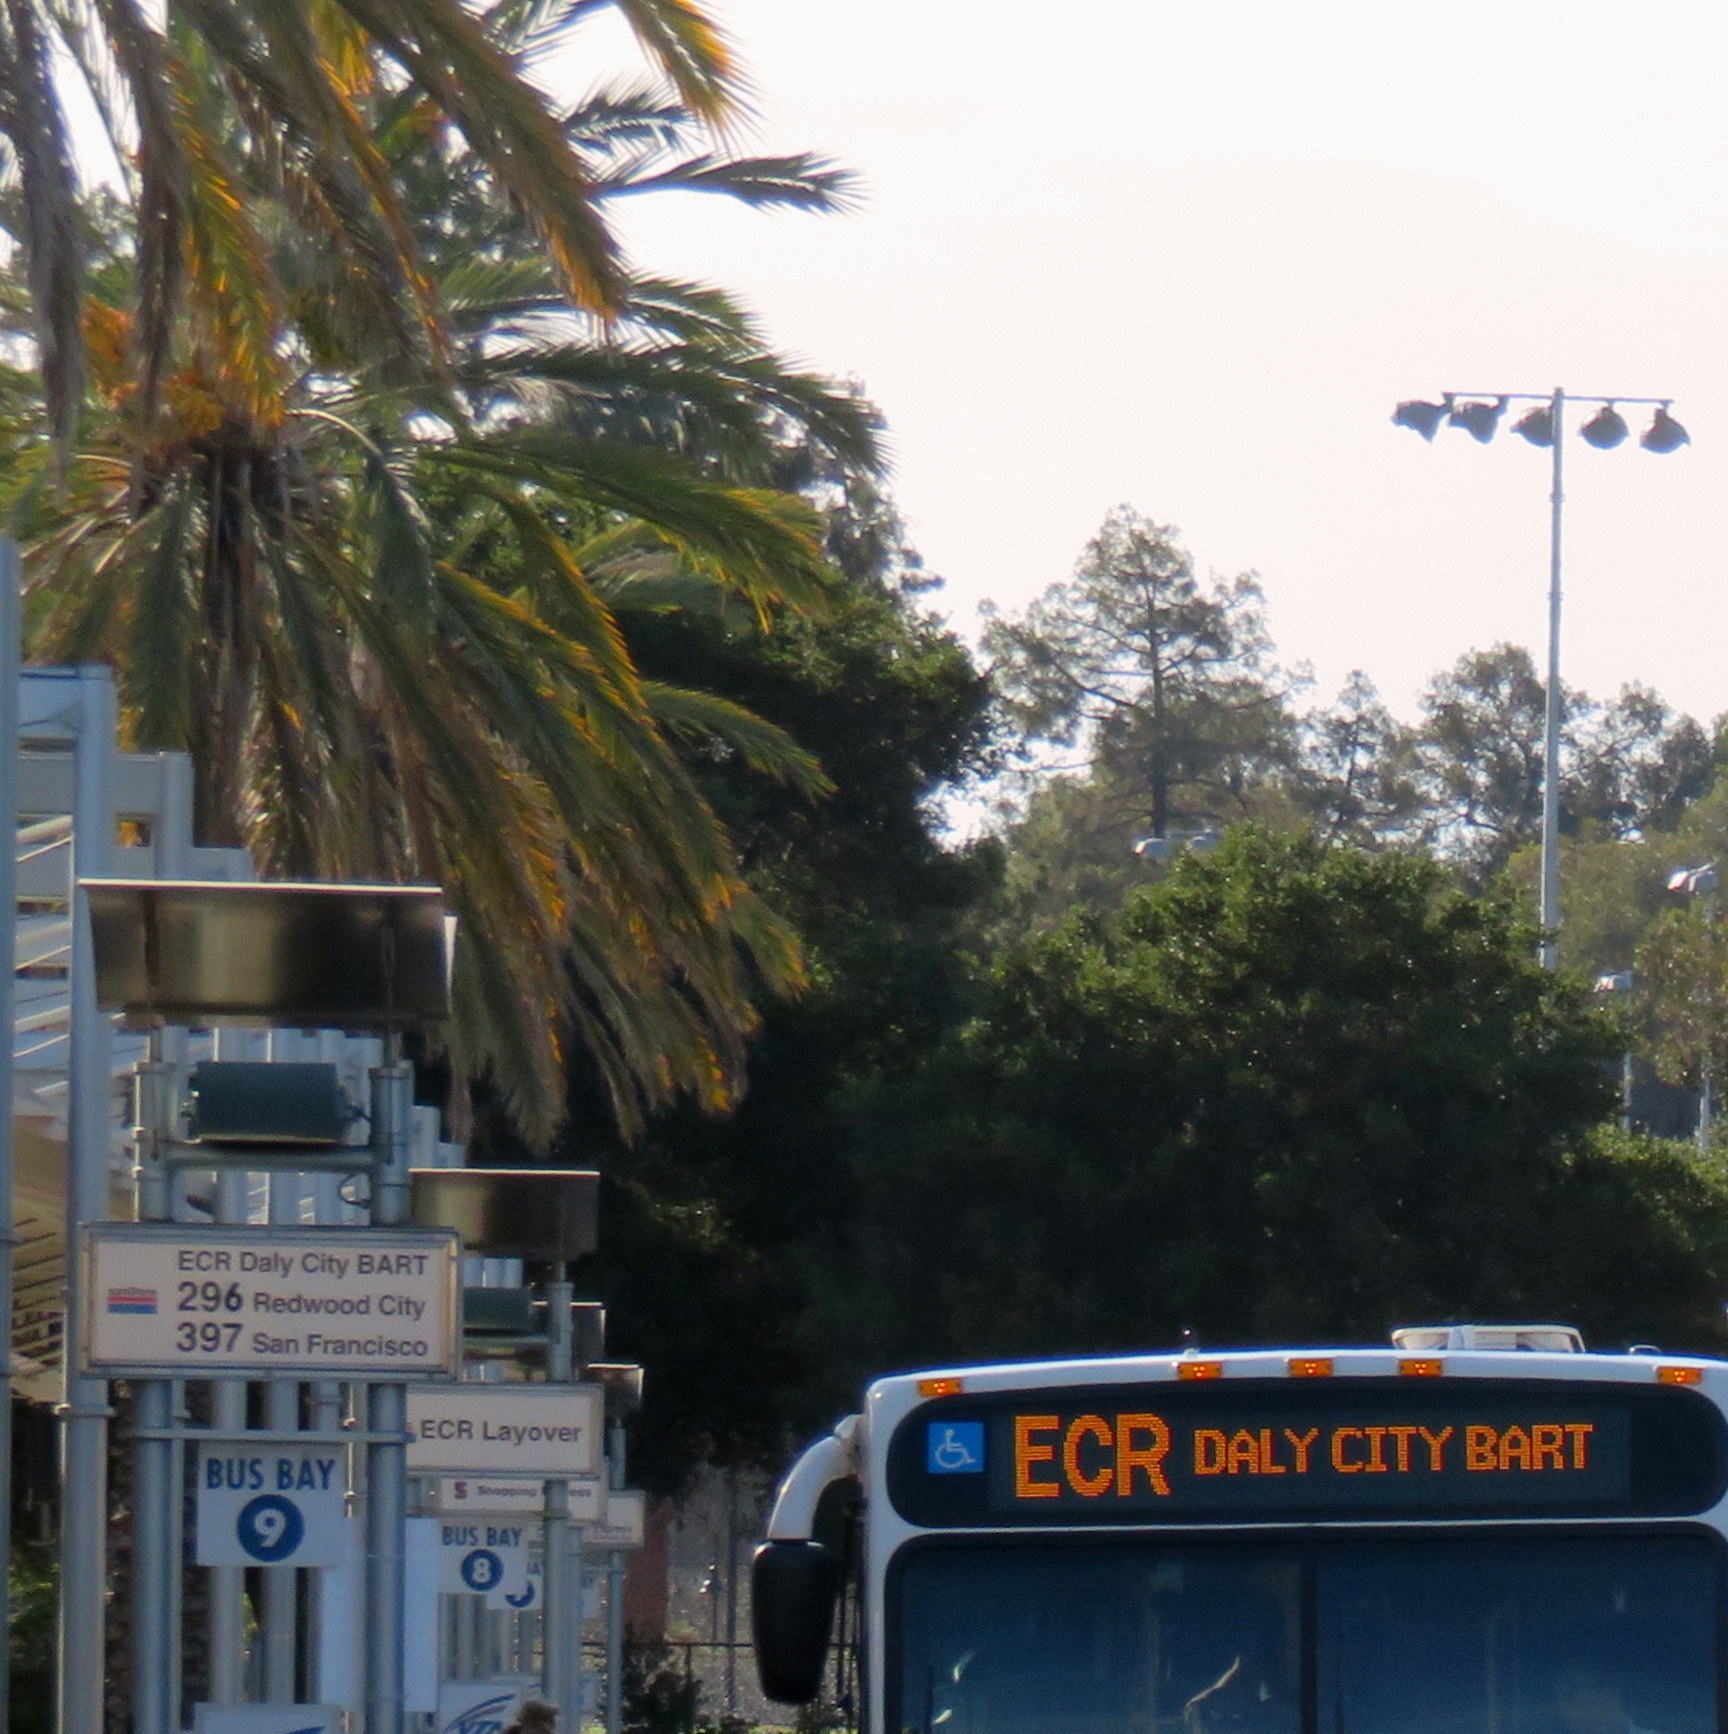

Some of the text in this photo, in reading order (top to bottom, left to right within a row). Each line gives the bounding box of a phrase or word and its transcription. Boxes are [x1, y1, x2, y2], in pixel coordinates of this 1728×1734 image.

[177, 1250, 429, 1279] ECR Daly City BART
[176, 1281, 426, 1321] 296 Redwood City
[176, 1322, 428, 1357] 397 San Francisco
[420, 1419, 582, 1446] ECR Layover
[1015, 1412, 1595, 1498] ECR DALY CITY BART
[206, 1457, 336, 1491] BUS BAY
[254, 1507, 287, 1548] 9
[441, 1526, 523, 1547] BUS BAY
[471, 1557, 491, 1584] 8
